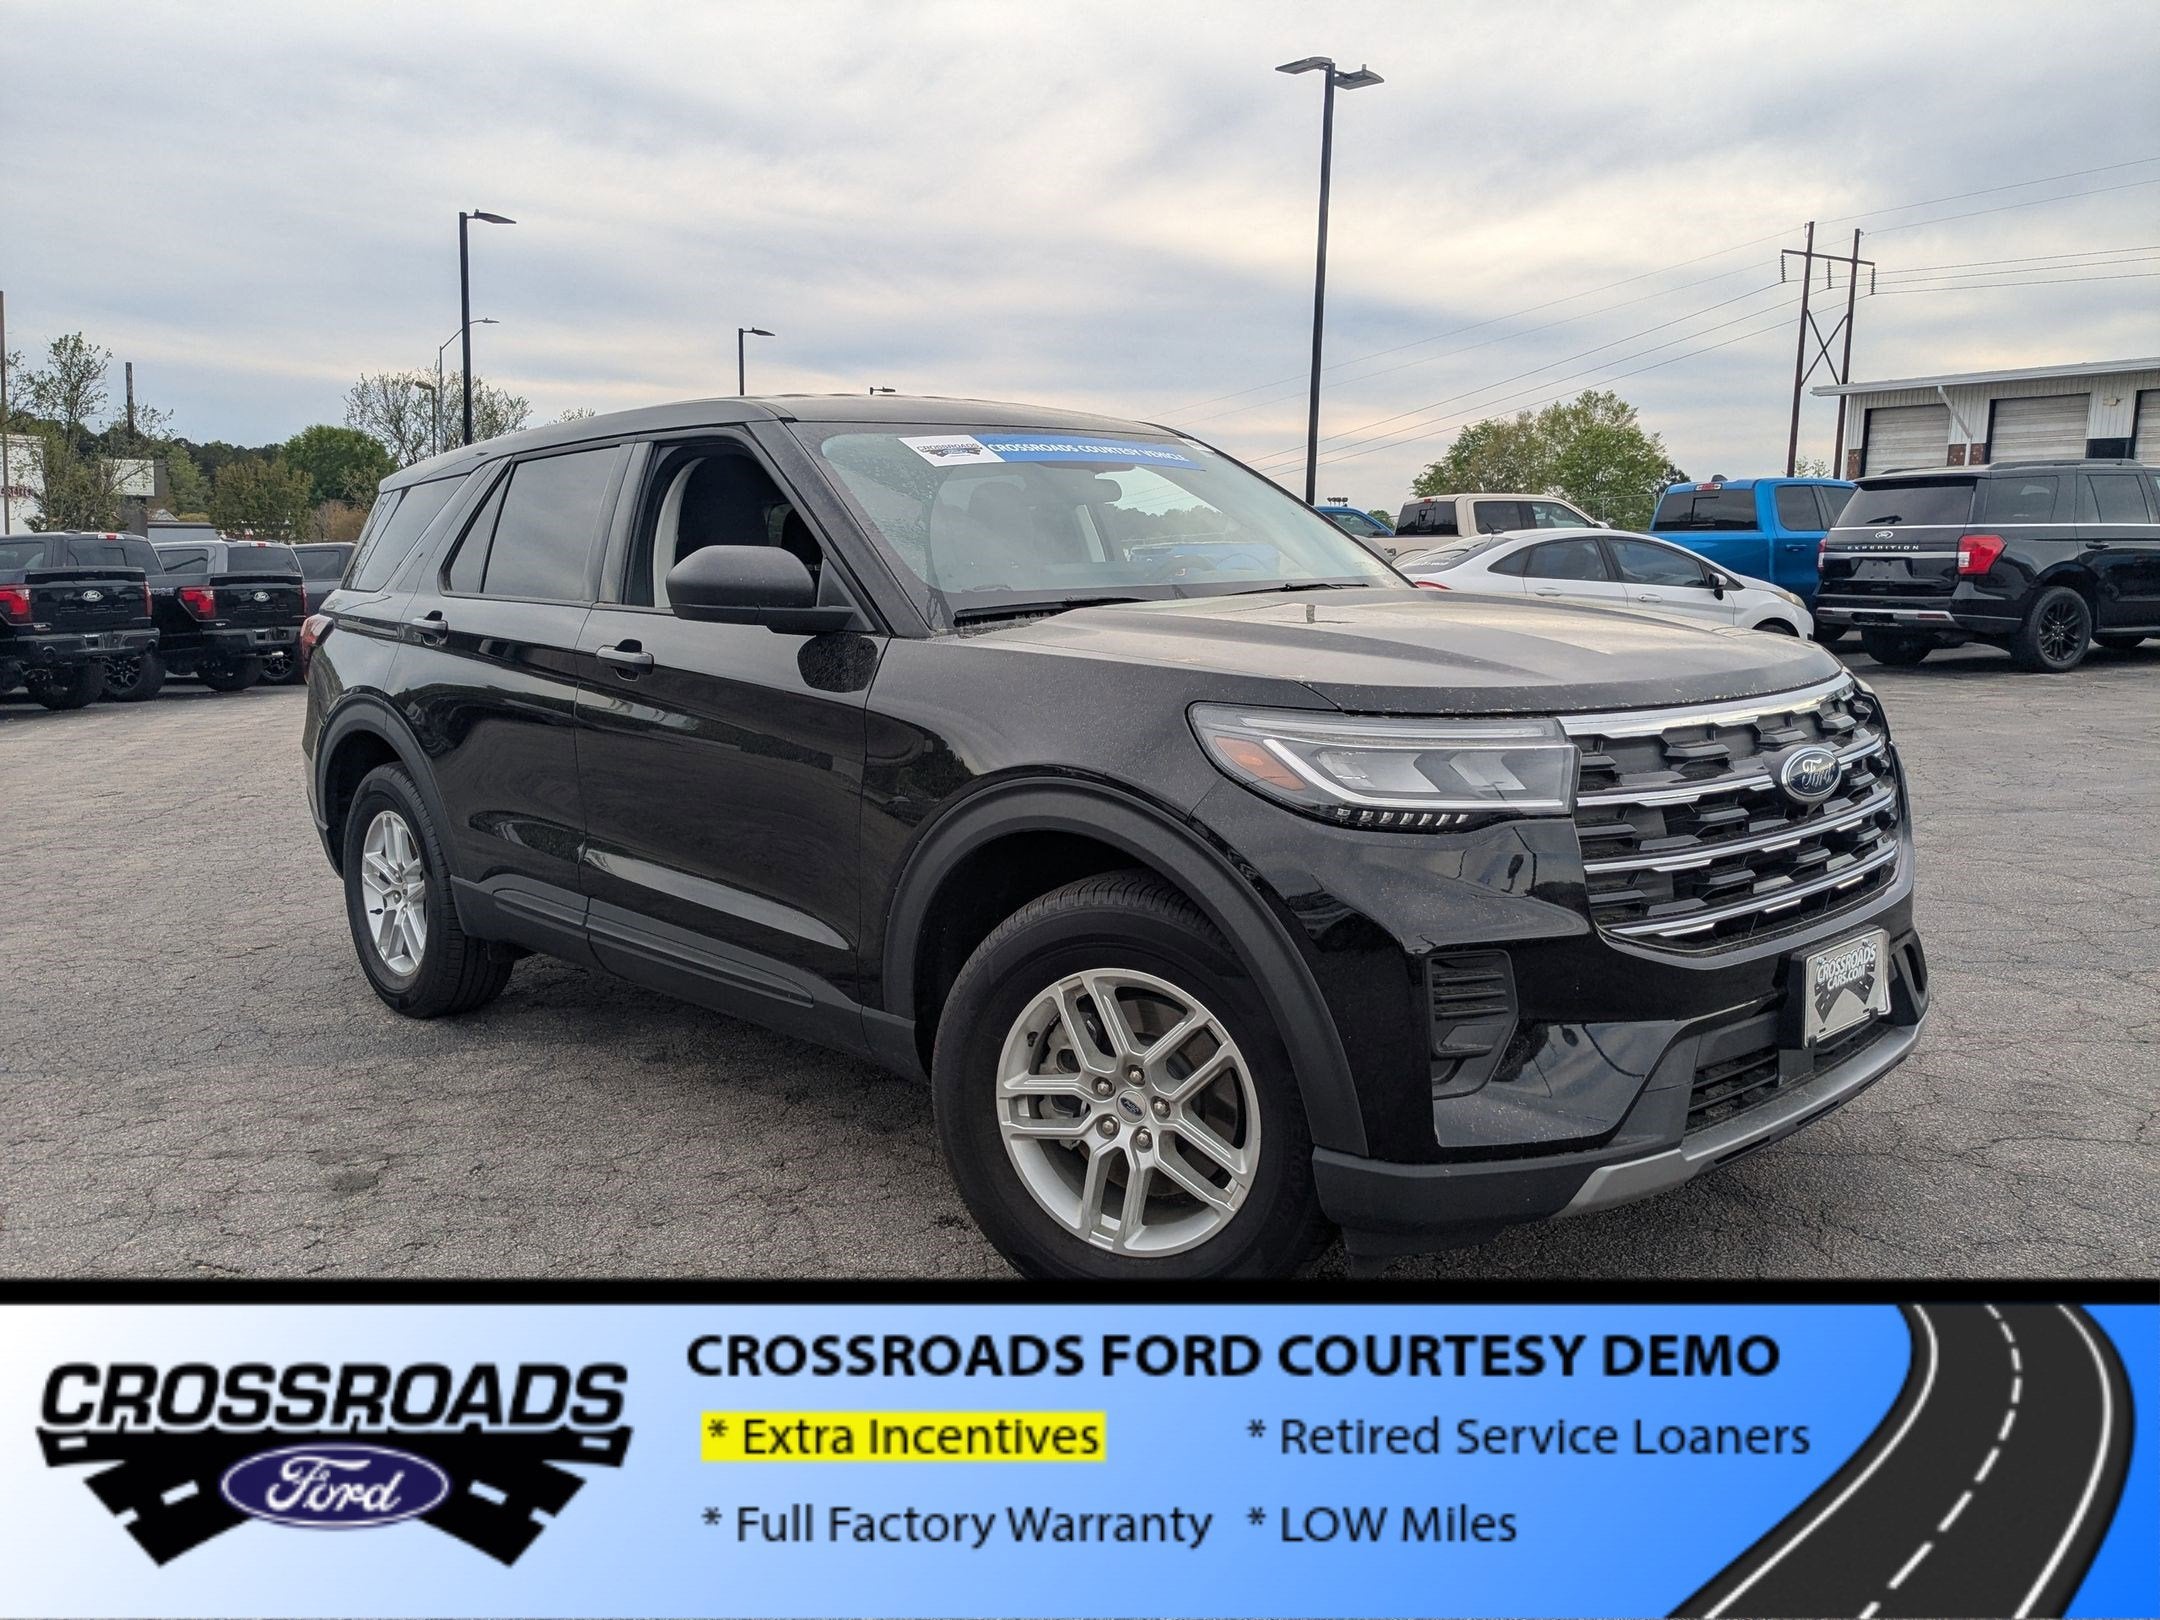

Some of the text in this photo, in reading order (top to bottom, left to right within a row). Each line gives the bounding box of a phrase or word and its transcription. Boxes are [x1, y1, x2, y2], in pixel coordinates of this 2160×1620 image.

[987, 443, 1078, 453] CROSSROADS
[1078, 445, 1141, 456] COURTESY
[1801, 758, 1835, 790] Ford
[1816, 943, 1877, 983] CROSSROADS
[1827, 964, 1866, 991] CARS.COM
